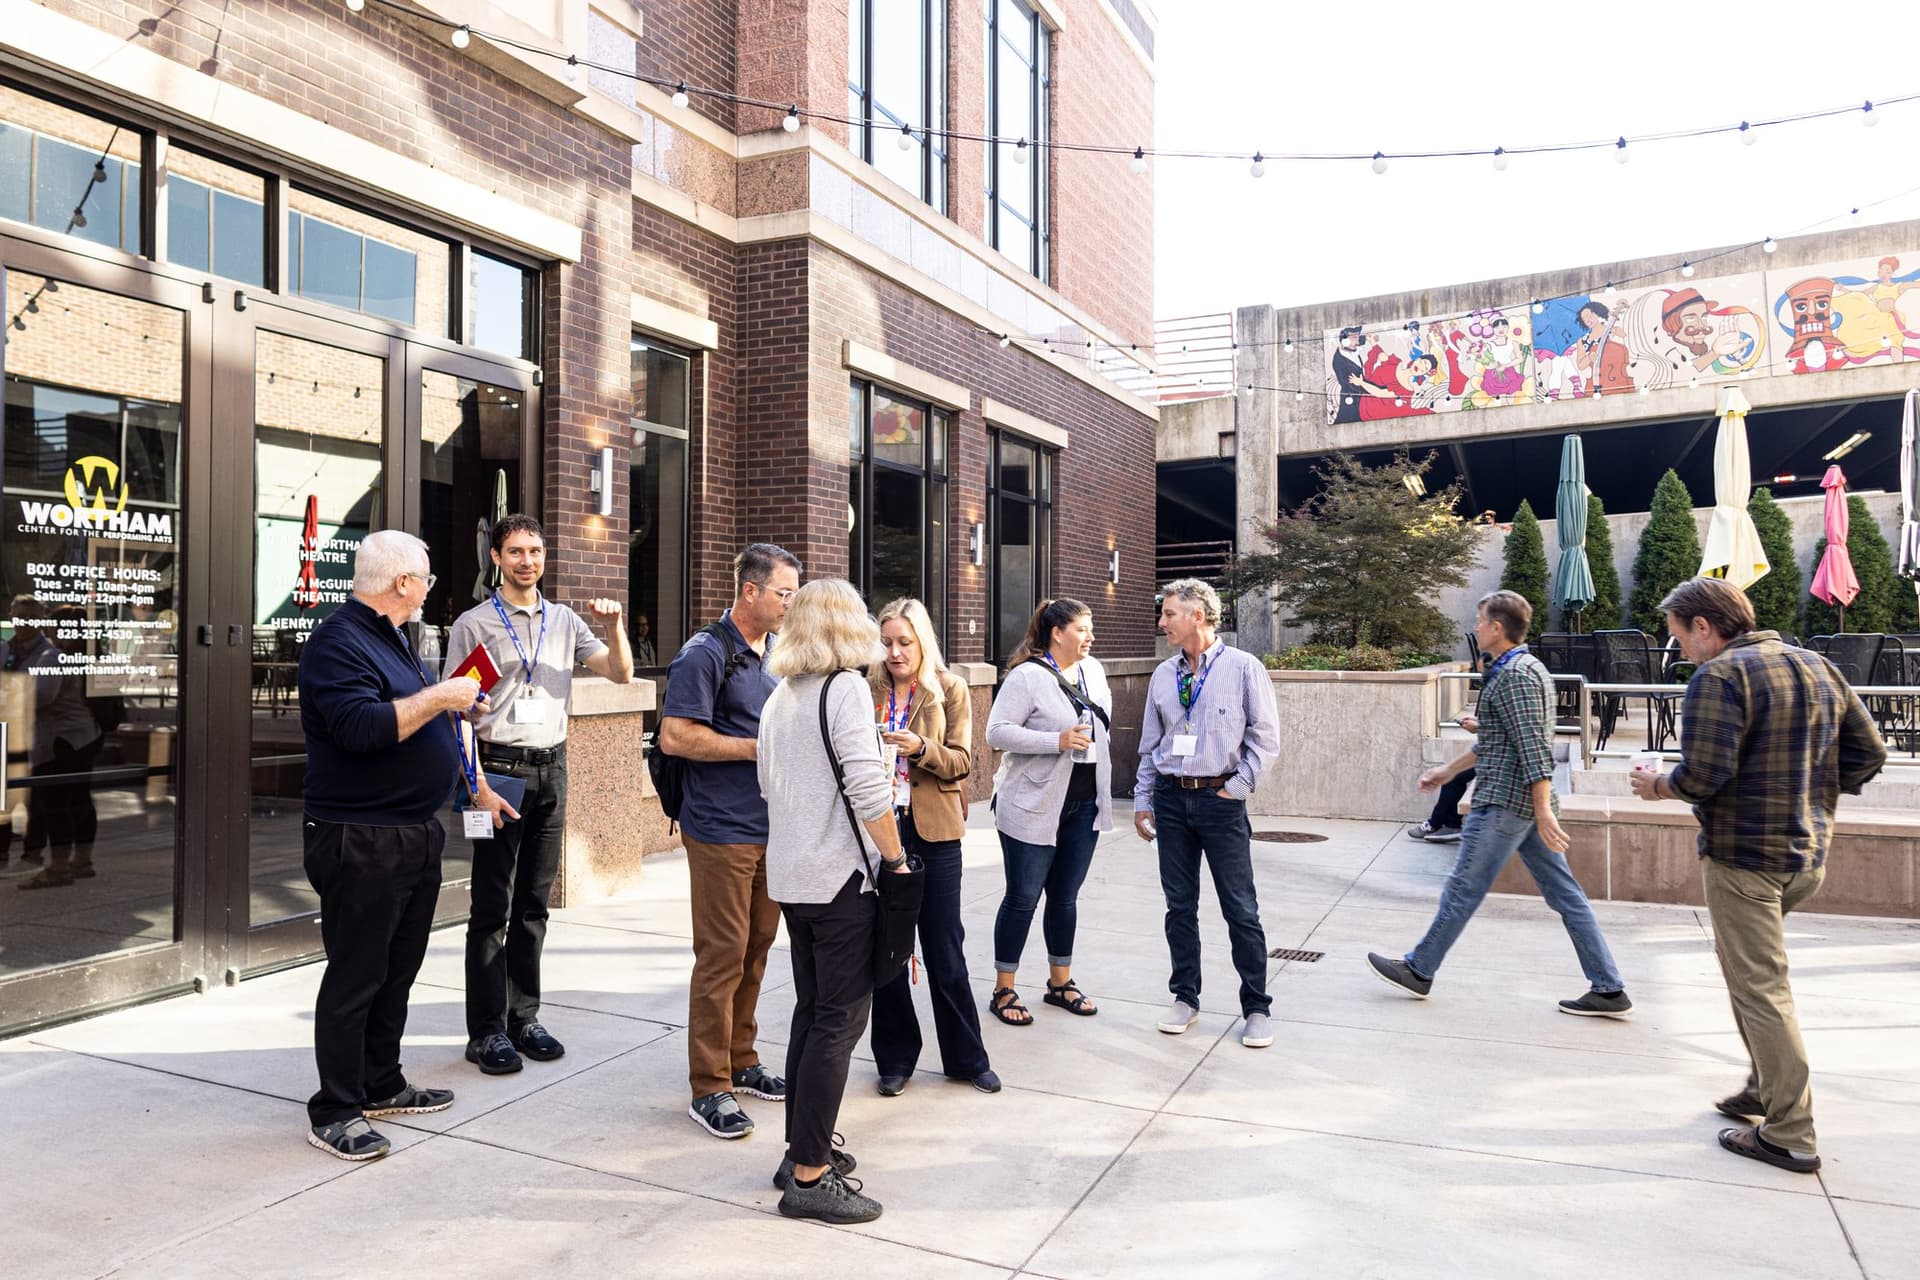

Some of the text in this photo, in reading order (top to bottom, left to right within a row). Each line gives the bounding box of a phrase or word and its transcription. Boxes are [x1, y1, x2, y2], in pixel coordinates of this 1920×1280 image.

[20, 501, 172, 535] WORTHAM
[17, 524, 173, 544] CENTER FOR THE PERFORMING ARTS
[299, 550, 348, 564] HEATRE
[26, 562, 56, 576] BOX
[59, 564, 107, 579] OFFICE
[113, 567, 161, 582] HOURS:
[33, 577, 62, 590] Tues
[73, 579, 94, 591] Fri:
[96, 581, 155, 595] 10am-4pm
[309, 578, 354, 591] McGUIR
[33, 590, 154, 606] Saturday: 12pm-4pm
[291, 591, 347, 604] THEATRE
[11, 617, 58, 629] Re-opens
[60, 619, 78, 627] one
[80, 617, 103, 628] hour
[271, 617, 315, 630] HENRY
[56, 629, 133, 640] 828-257-4530
[58, 653, 131, 664] Online sales:
[28, 664, 158, 677] www.worthamarts.org
